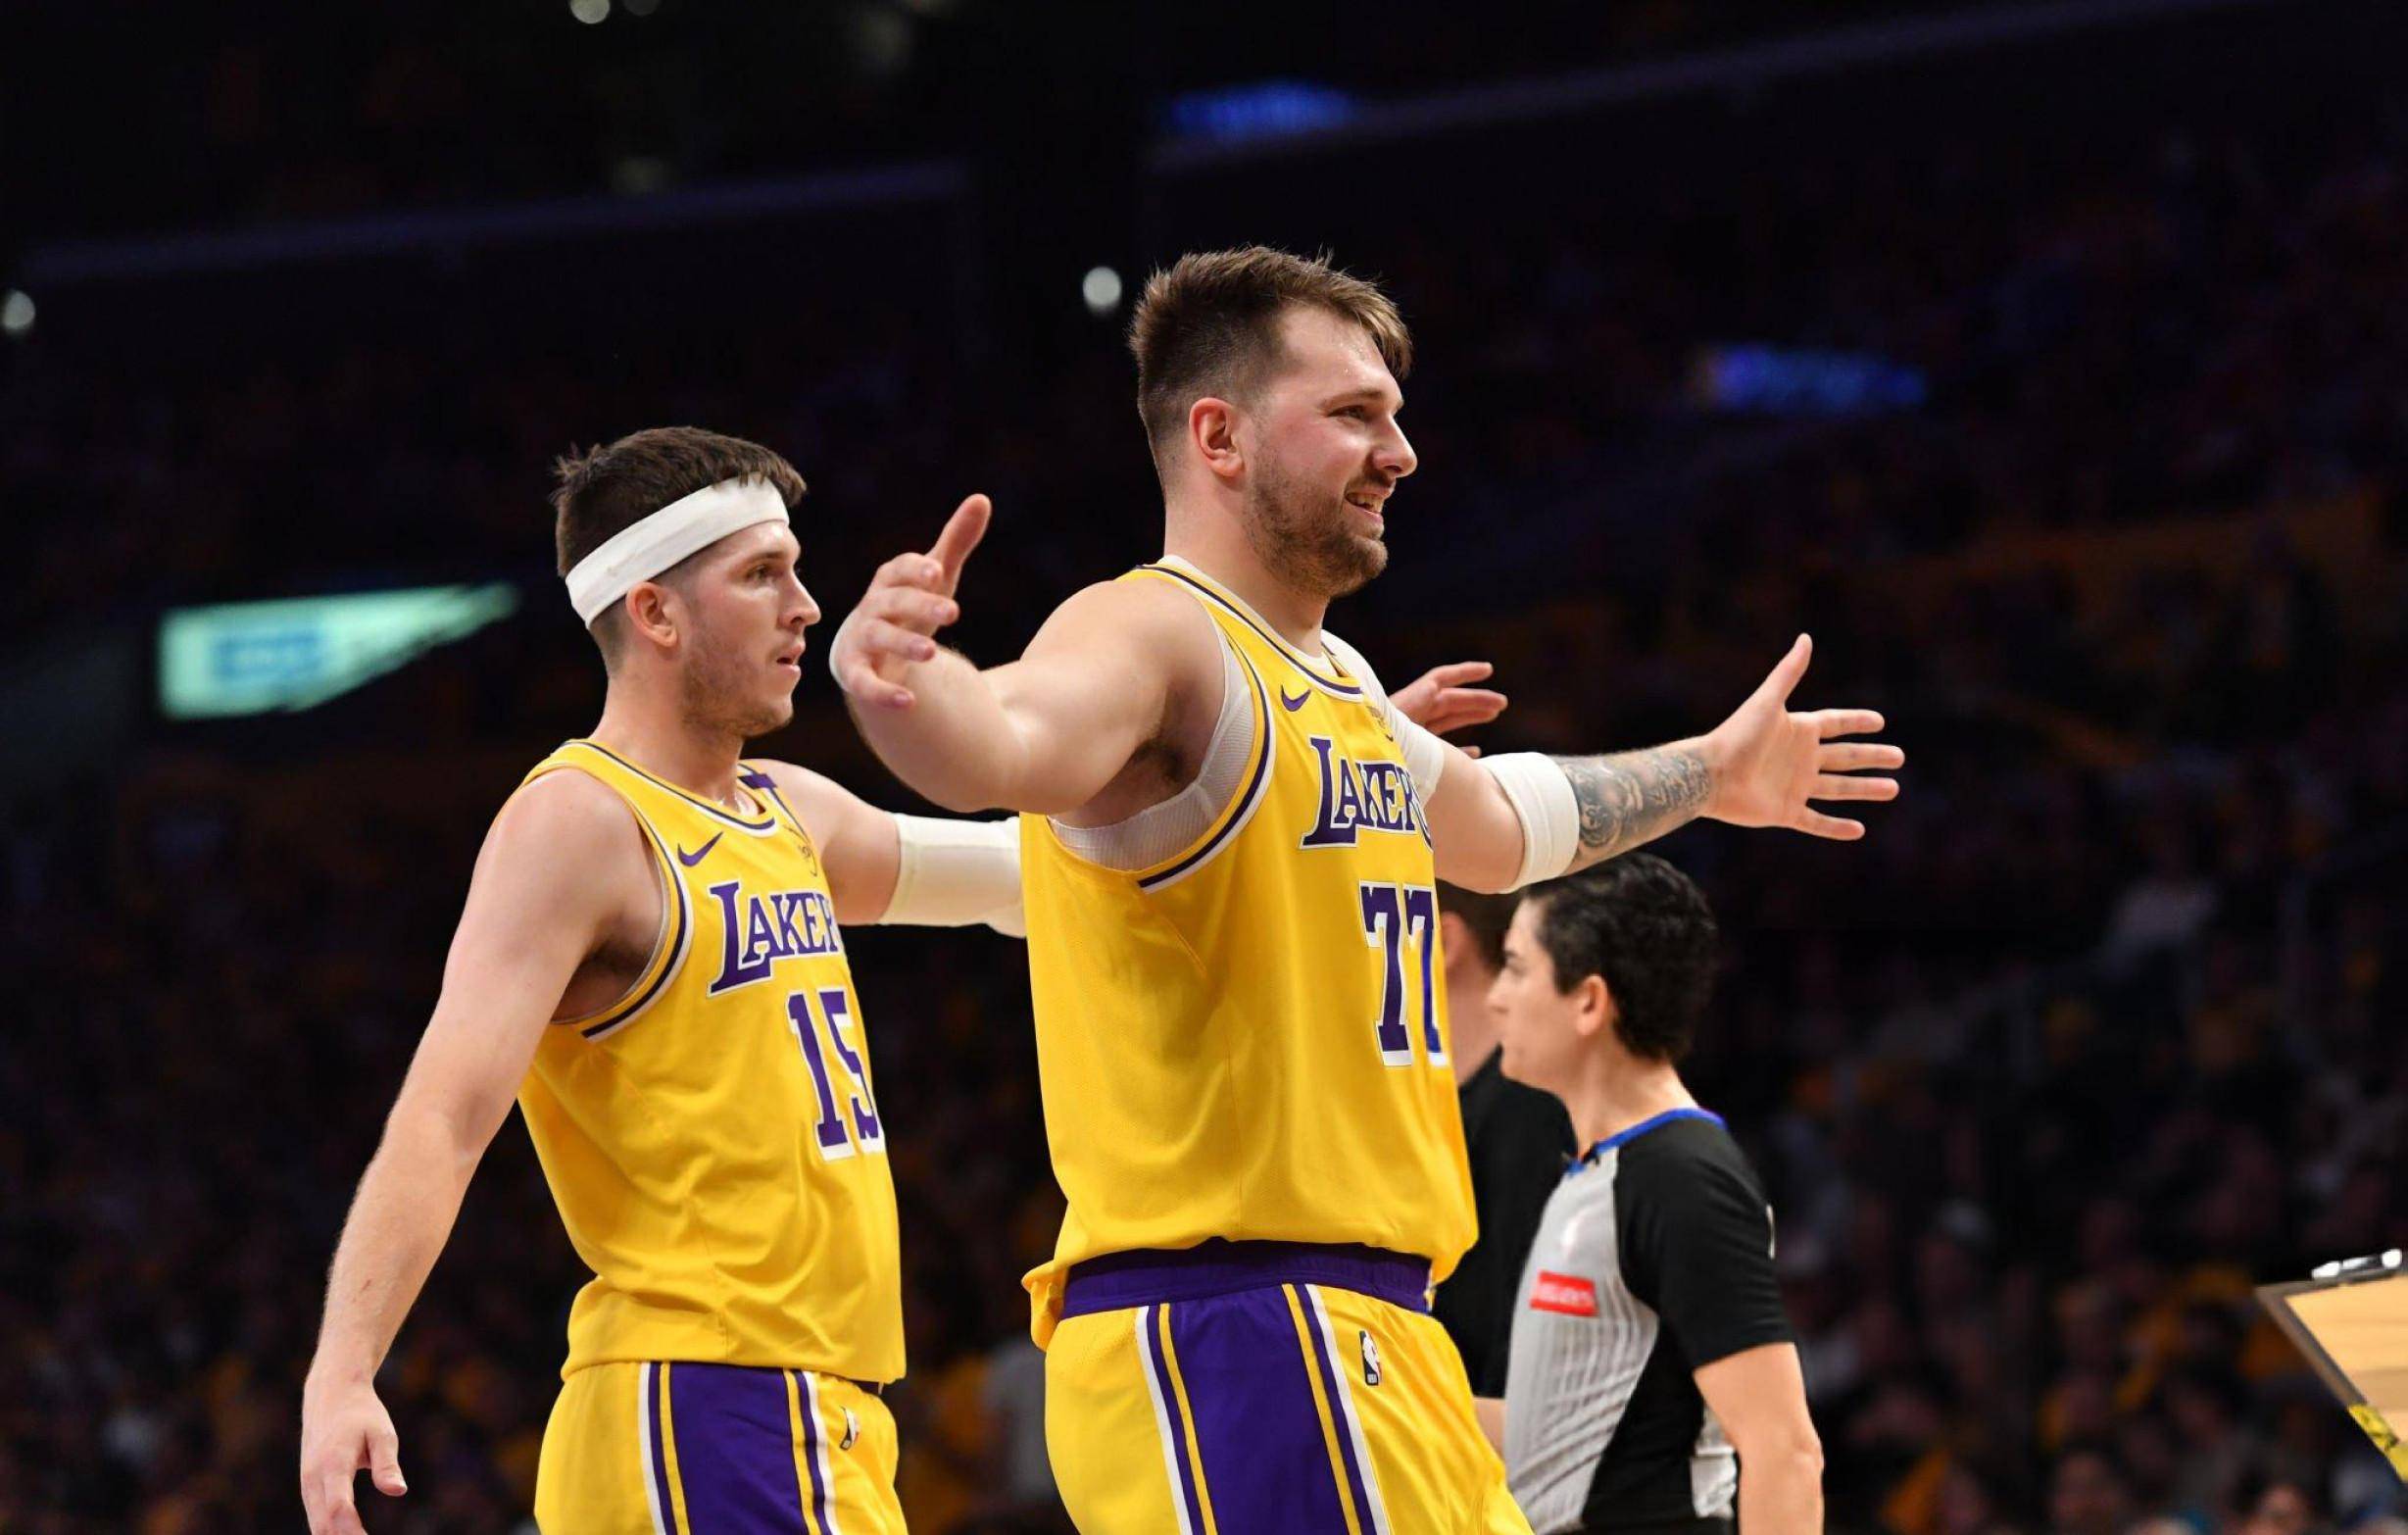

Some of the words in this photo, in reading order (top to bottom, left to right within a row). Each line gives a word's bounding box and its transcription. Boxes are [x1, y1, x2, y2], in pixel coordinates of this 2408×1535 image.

[1301, 736, 1432, 849] LAKER
[1359, 880, 1449, 1066] 77
[786, 988, 884, 1160] 15
